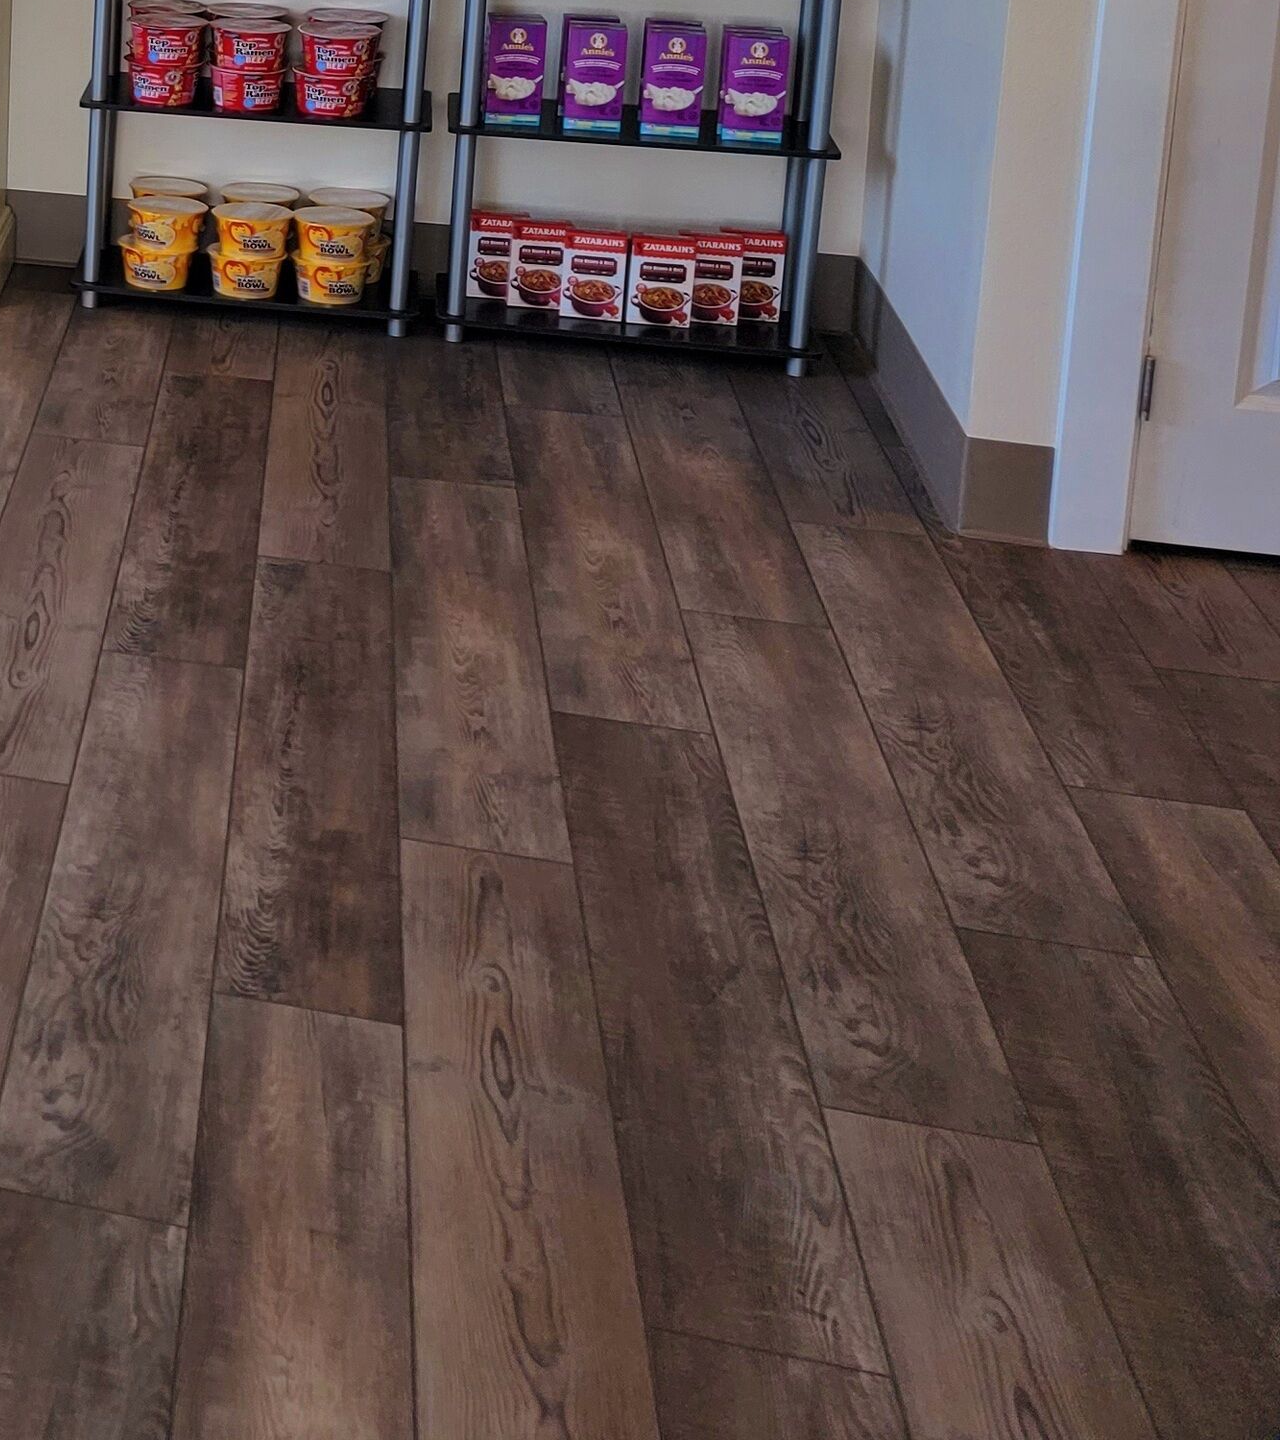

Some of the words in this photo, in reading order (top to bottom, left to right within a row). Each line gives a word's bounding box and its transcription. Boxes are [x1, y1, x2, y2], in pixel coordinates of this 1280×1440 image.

[149, 37, 169, 49] Top
[234, 39, 256, 51] Top
[501, 43, 534, 52] Annie's
[150, 45, 187, 55] Ramen
[235, 48, 274, 57] Ramen
[316, 46, 336, 57] Top
[581, 47, 615, 57] Annie's
[317, 55, 356, 64] Ramen
[659, 53, 694, 62] Annie's
[741, 57, 776, 67] Annie's
[245, 82, 265, 93] Top
[306, 85, 325, 95] Top
[307, 93, 344, 103] Ramen
[574, 236, 625, 248] ZATARAIN'S
[320, 247, 351, 255] BOWL
[643, 242, 695, 254] ZATARAIN'S
[135, 272, 161, 280] BOWL
[328, 287, 357, 295] BOWL
